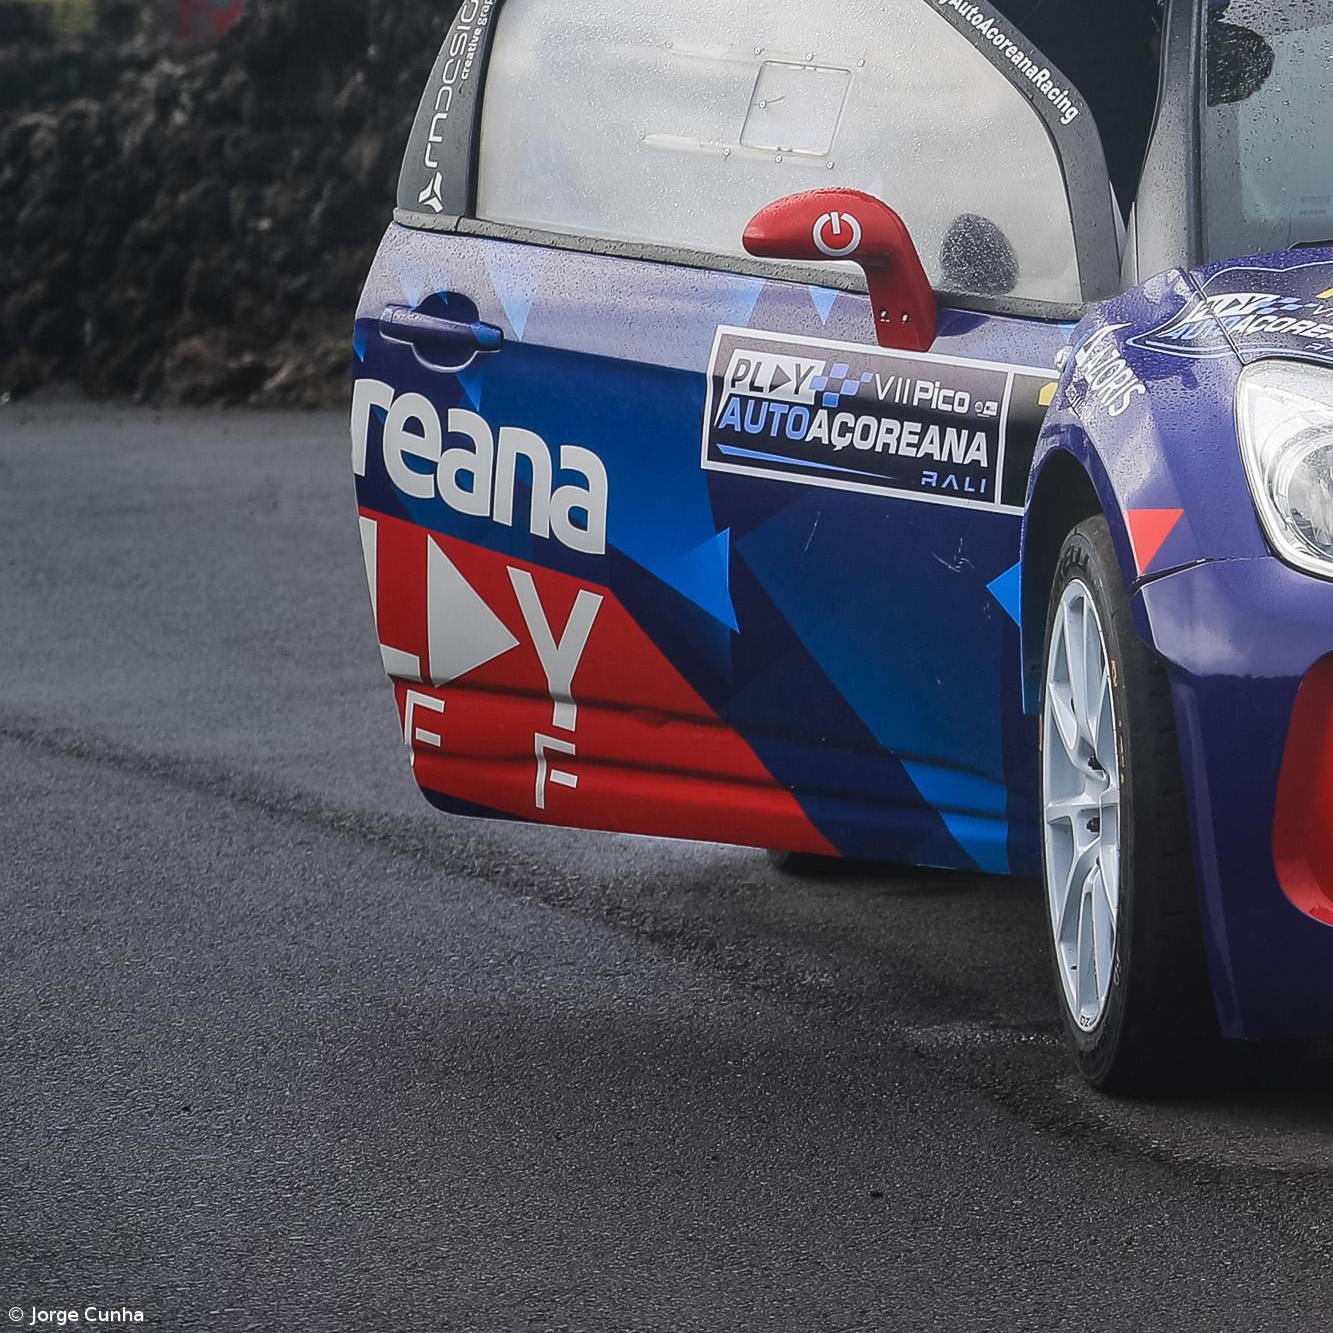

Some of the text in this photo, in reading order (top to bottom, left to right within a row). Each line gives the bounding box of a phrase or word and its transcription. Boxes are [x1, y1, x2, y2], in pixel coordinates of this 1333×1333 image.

[461, 27, 482, 80] creative
[718, 397, 988, 468] AUTOAÇOREANA
[921, 471, 987, 493] RALI
